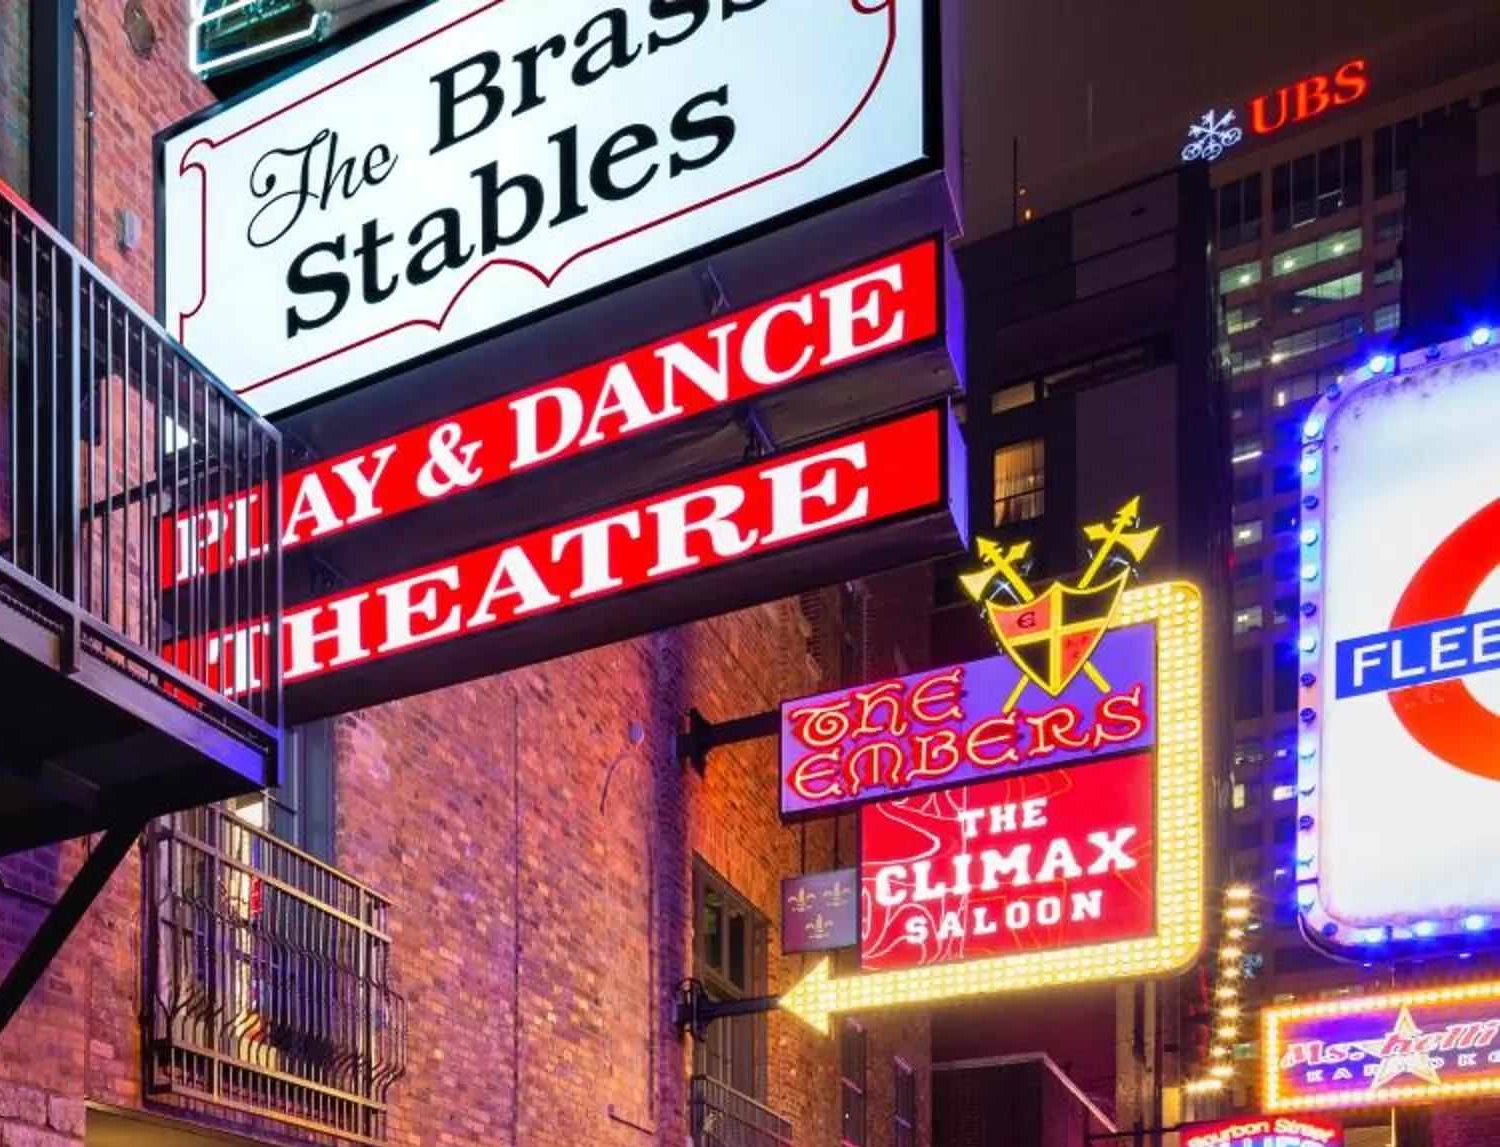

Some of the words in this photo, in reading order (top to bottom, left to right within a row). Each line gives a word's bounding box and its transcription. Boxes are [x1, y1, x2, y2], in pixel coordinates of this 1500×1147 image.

[248, 127, 398, 249] The
[429, 0, 768, 155] Bras
[1248, 58, 1369, 135] UBS
[285, 84, 737, 338] Stables
[176, 444, 397, 582] PLAY
[416, 422, 483, 498] &
[509, 263, 905, 470] DANCE
[206, 440, 869, 696] THEATRE
[791, 667, 965, 748] THE
[791, 685, 1144, 800] EMBERS
[874, 827, 1137, 906] CLIMAX
[957, 798, 1048, 840] THE
[906, 890, 1104, 945] SALOON
